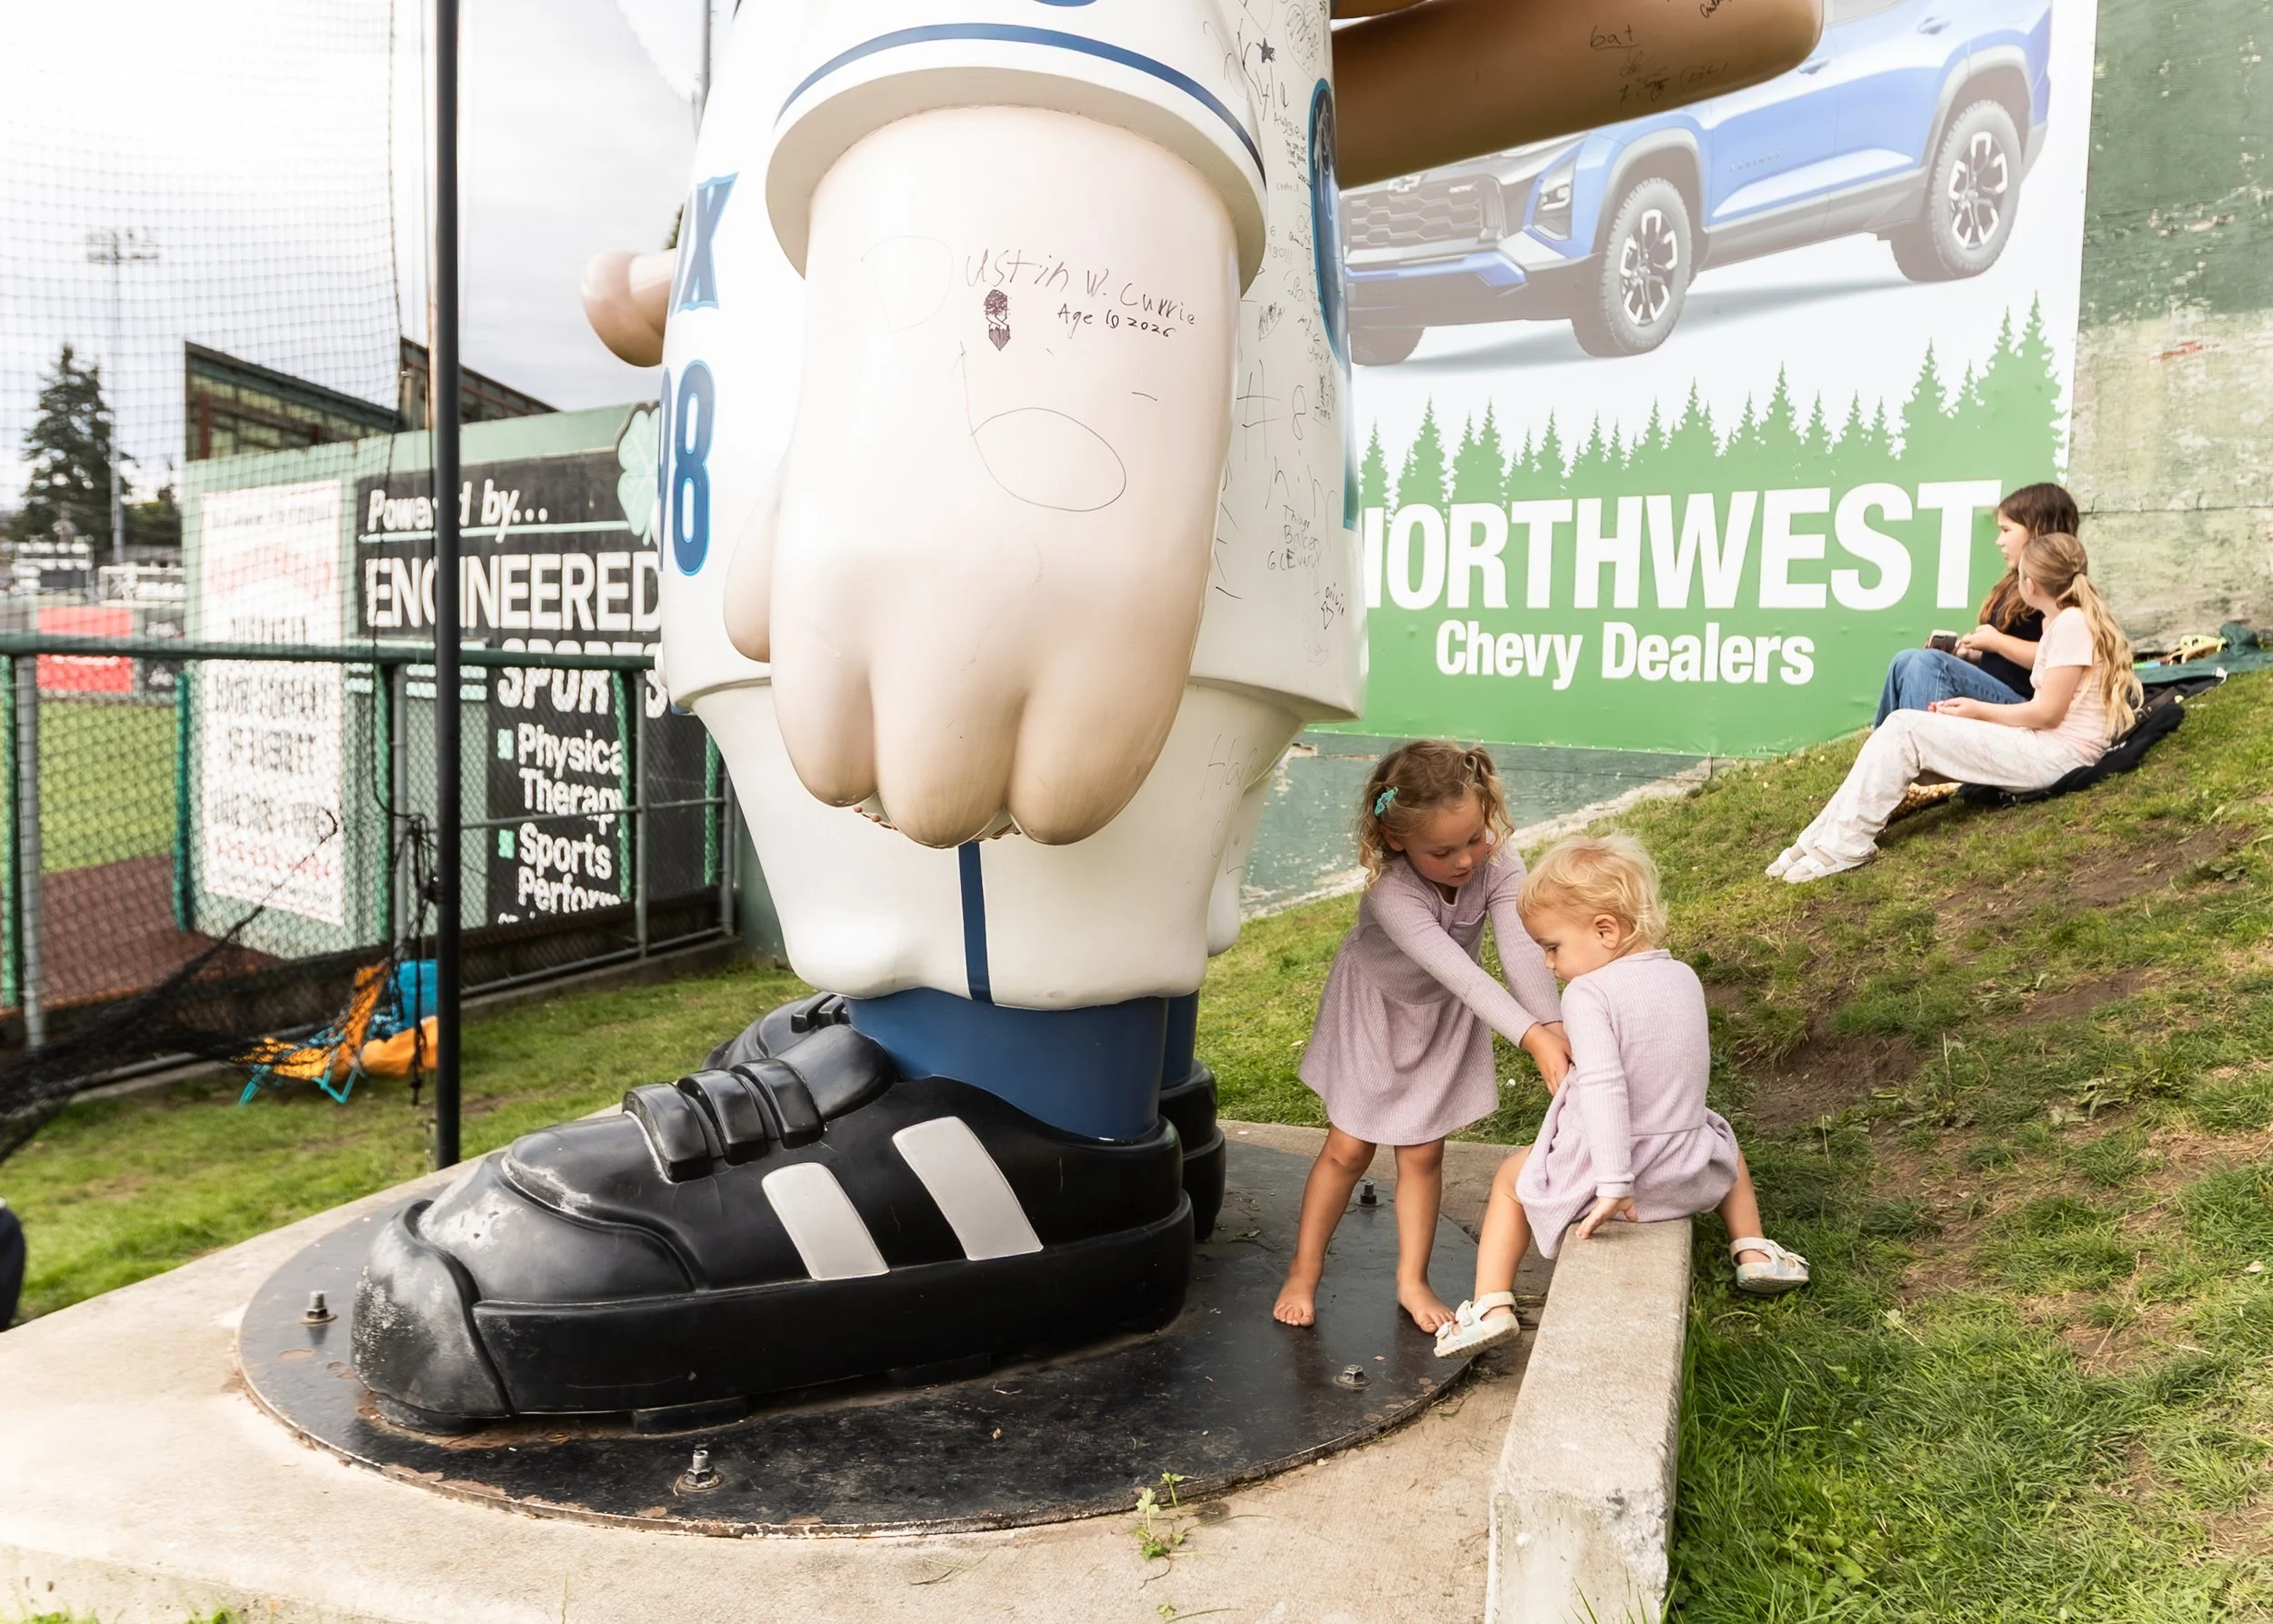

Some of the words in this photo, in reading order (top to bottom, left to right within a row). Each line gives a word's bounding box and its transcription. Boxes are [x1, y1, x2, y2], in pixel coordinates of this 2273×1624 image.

[669, 171, 739, 317] X
[1057, 303, 1094, 339] Age
[367, 480, 473, 533] Powerd
[1436, 619, 1583, 689] Chevy
[1601, 620, 1814, 686] Dealers
[517, 722, 624, 779] Physica
[519, 821, 613, 880] Sports
